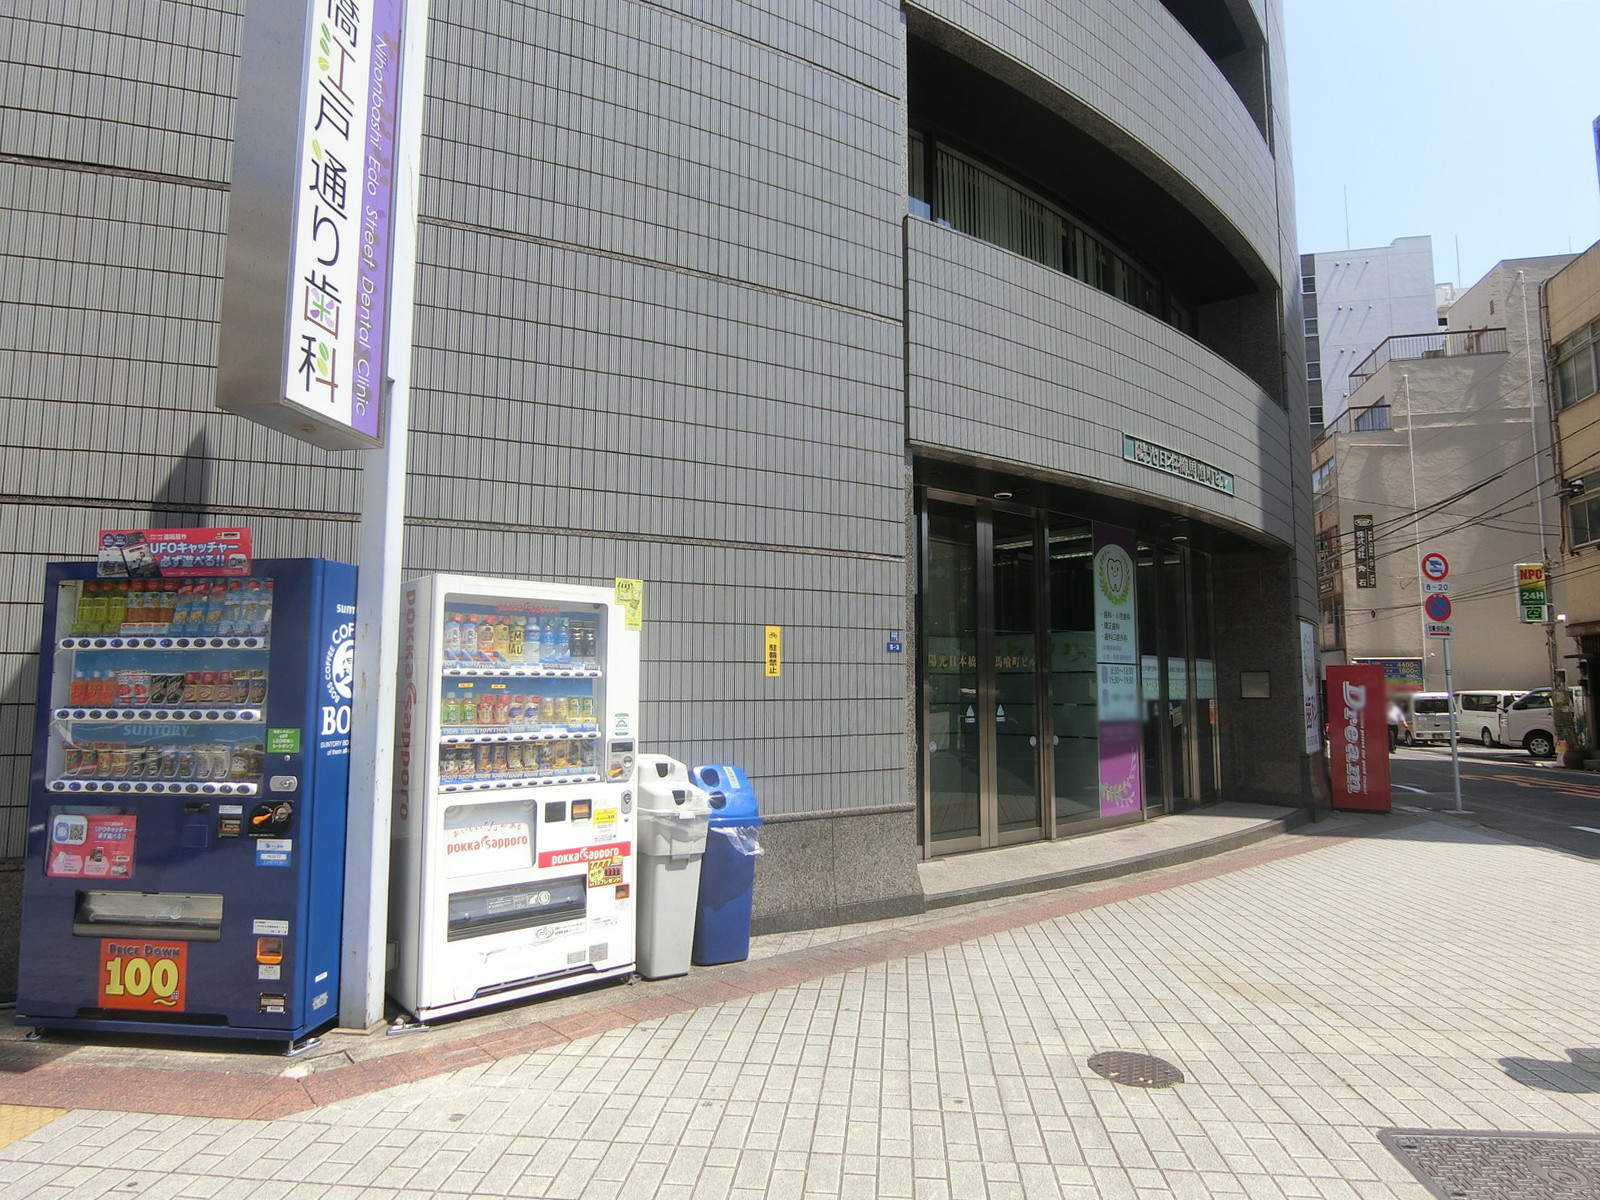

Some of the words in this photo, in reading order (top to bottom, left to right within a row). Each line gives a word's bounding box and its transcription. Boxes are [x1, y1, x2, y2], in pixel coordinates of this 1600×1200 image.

[370, 35, 390, 150] Nihonbashi
[367, 155, 381, 196] Edo
[363, 205, 378, 268] Street
[359, 276, 374, 349] Dental
[356, 360, 370, 417] Clinic
[150, 541, 239, 554] UFOキャッチャー
[1520, 569, 1543, 580] NPC
[1522, 591, 1544, 600] 24H
[1342, 680, 1366, 794] Dream
[108, 942, 141, 957] PRICE
[143, 943, 180, 957] DOWN
